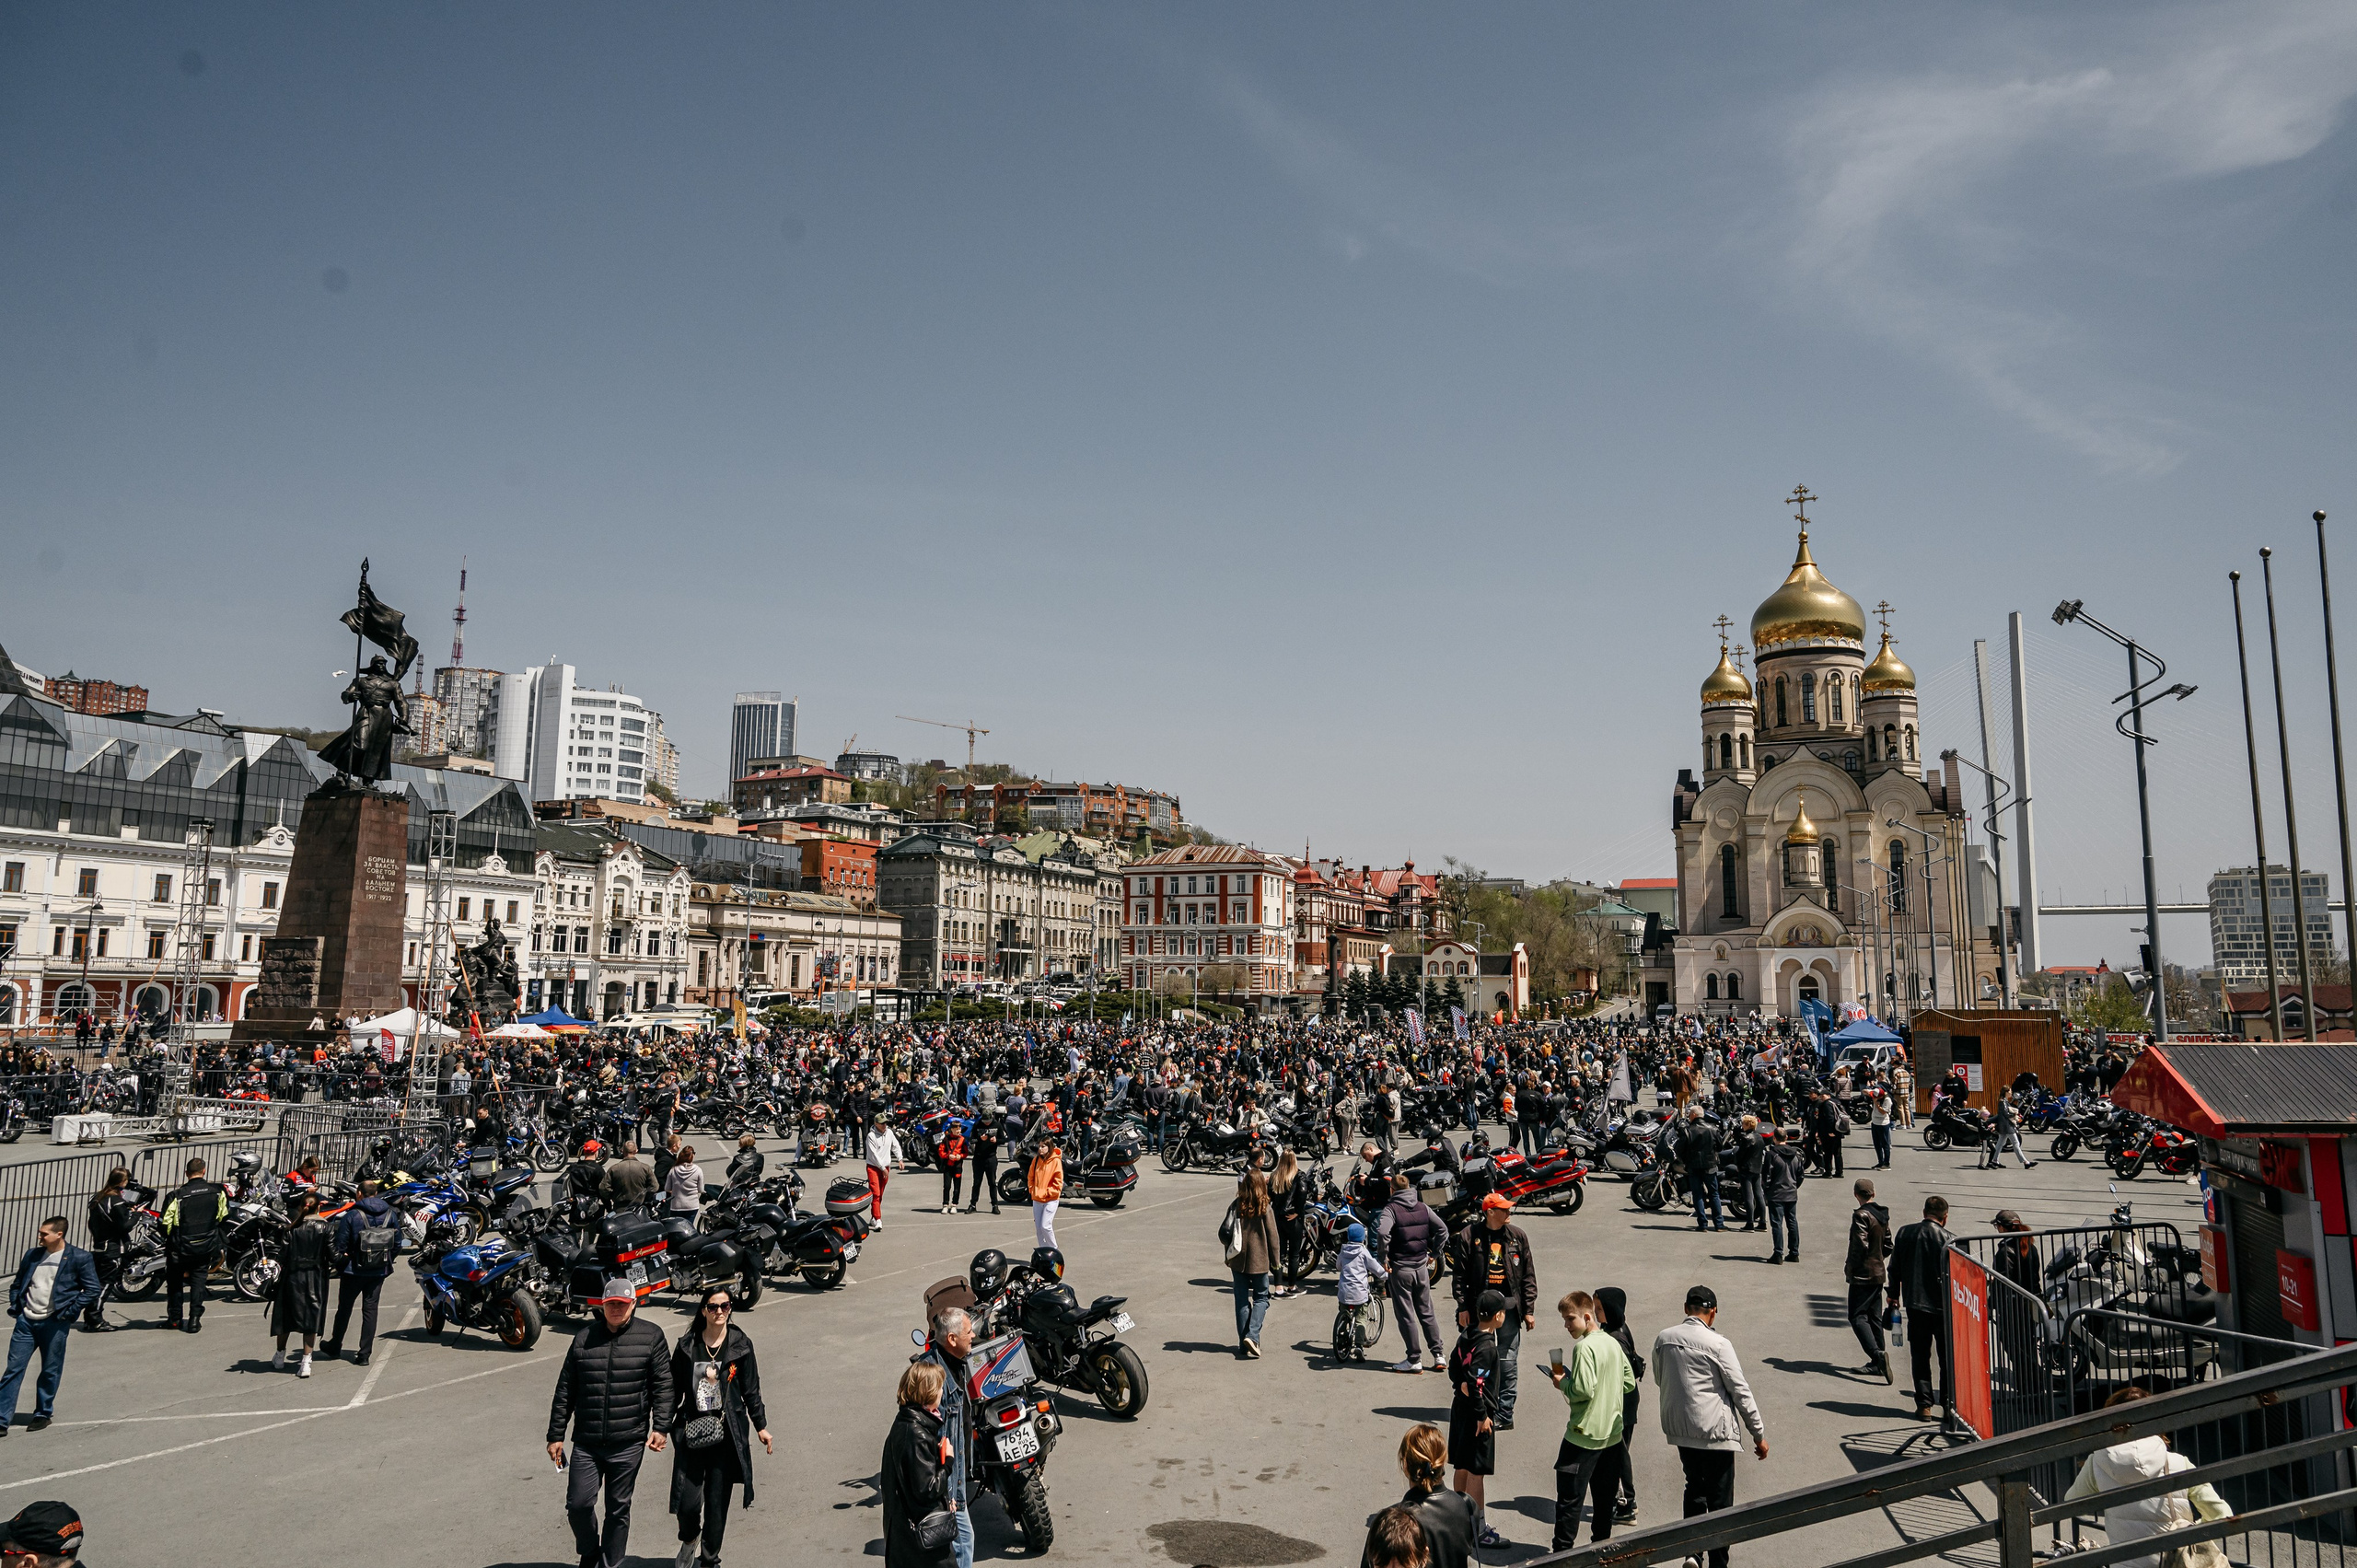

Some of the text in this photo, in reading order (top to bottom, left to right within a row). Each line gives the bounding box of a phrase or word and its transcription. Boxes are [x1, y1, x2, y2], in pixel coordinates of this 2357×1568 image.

[365, 885, 395, 893] ВОСТОКЕ
[366, 879, 396, 888] ДАЛЬНЕМ
[2281, 1274, 2298, 1296] 10-21
[1001, 1427, 1030, 1446] 7694
[1023, 1440, 1038, 1455] 25
